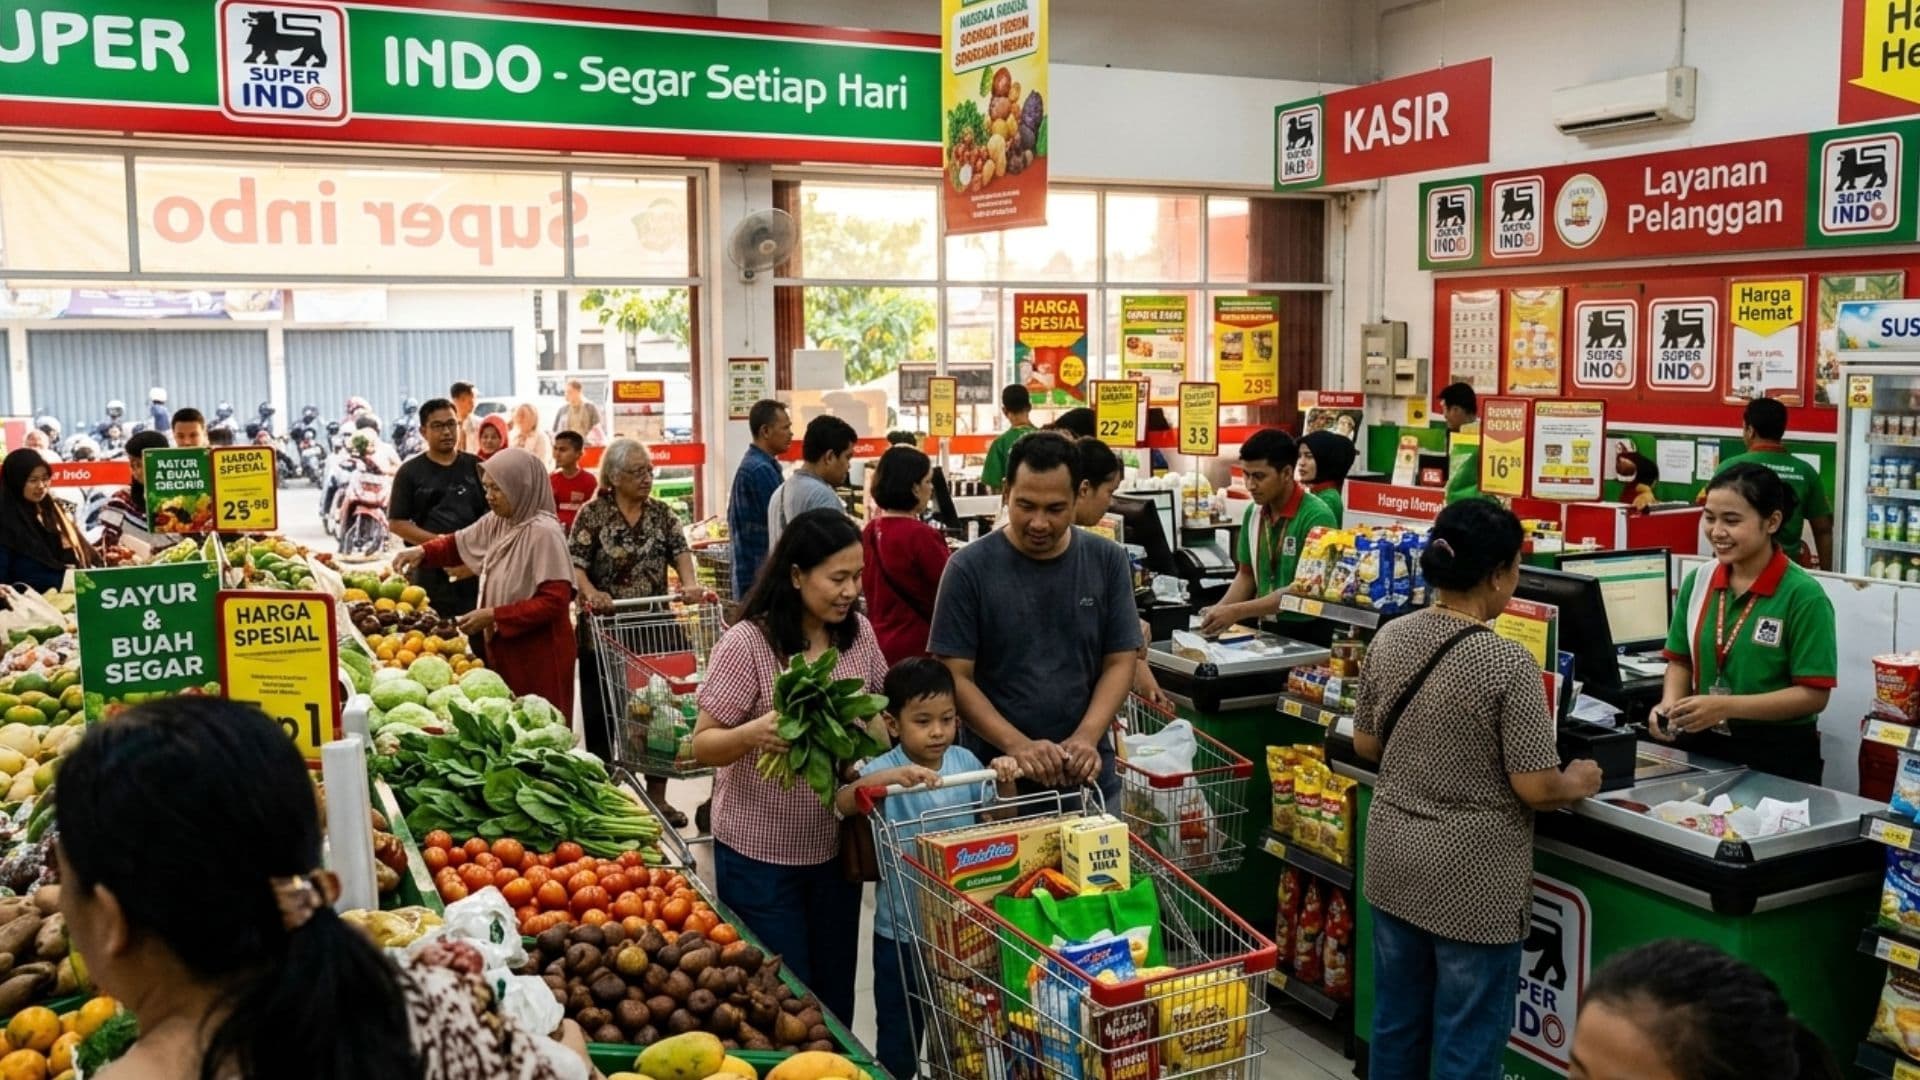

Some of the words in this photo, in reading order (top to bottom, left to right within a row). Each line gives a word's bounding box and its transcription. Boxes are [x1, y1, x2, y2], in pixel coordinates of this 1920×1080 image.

[249, 66, 320, 84] SUPER
[385, 36, 541, 94] INDO
[580, 56, 696, 105] Segar
[706, 64, 827, 113] Setiap
[838, 73, 907, 110] Hari
[242, 83, 332, 111] INDO
[1344, 92, 1450, 154] KASIR
[1645, 160, 1767, 201] Layanan
[1628, 198, 1784, 236] Pelanggan
[1832, 202, 1888, 224] INDO
[1023, 300, 1079, 314] HARGA
[1741, 287, 1791, 306] Harga
[1020, 316, 1085, 330] SPESIAL
[1738, 304, 1793, 323] Hemat
[1658, 362, 1706, 380] INDO
[101, 582, 197, 610] SAYUR
[142, 609, 162, 631] &
[236, 602, 311, 625] HARGA
[111, 631, 194, 659] BUAH
[234, 625, 320, 647] SPESIAL
[105, 656, 204, 685] SEGAR
[1516, 976, 1557, 1013] PER
